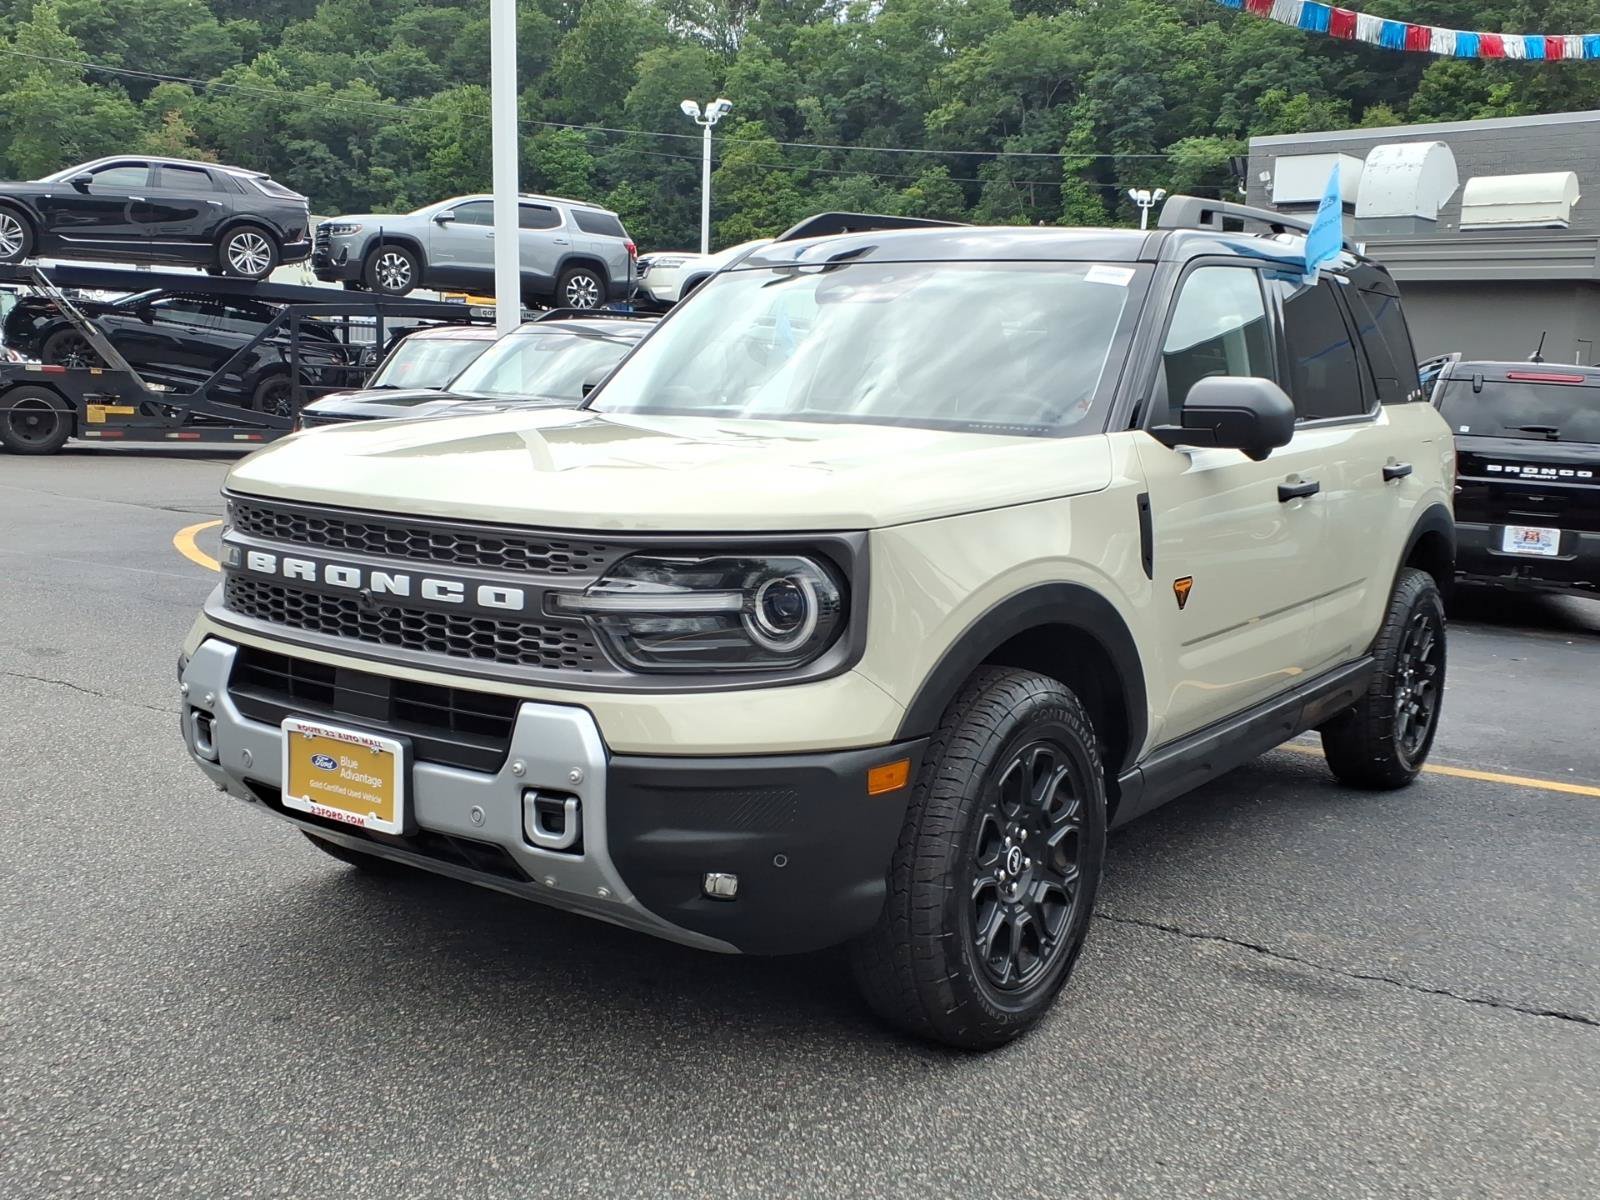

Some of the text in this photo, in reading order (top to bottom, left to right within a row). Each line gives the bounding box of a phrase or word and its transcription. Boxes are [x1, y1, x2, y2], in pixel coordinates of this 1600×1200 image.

[1487, 465, 1593, 478] BRONCO
[247, 550, 525, 611] BRONCO
[297, 724, 321, 735] ROUTE
[338, 732, 360, 743] AUTO
[361, 737, 384, 749] MALL
[314, 755, 335, 770] Ford
[340, 756, 359, 769] Blue
[340, 768, 383, 788] Advantage
[309, 780, 382, 804] Gold Certified Used Vehicle
